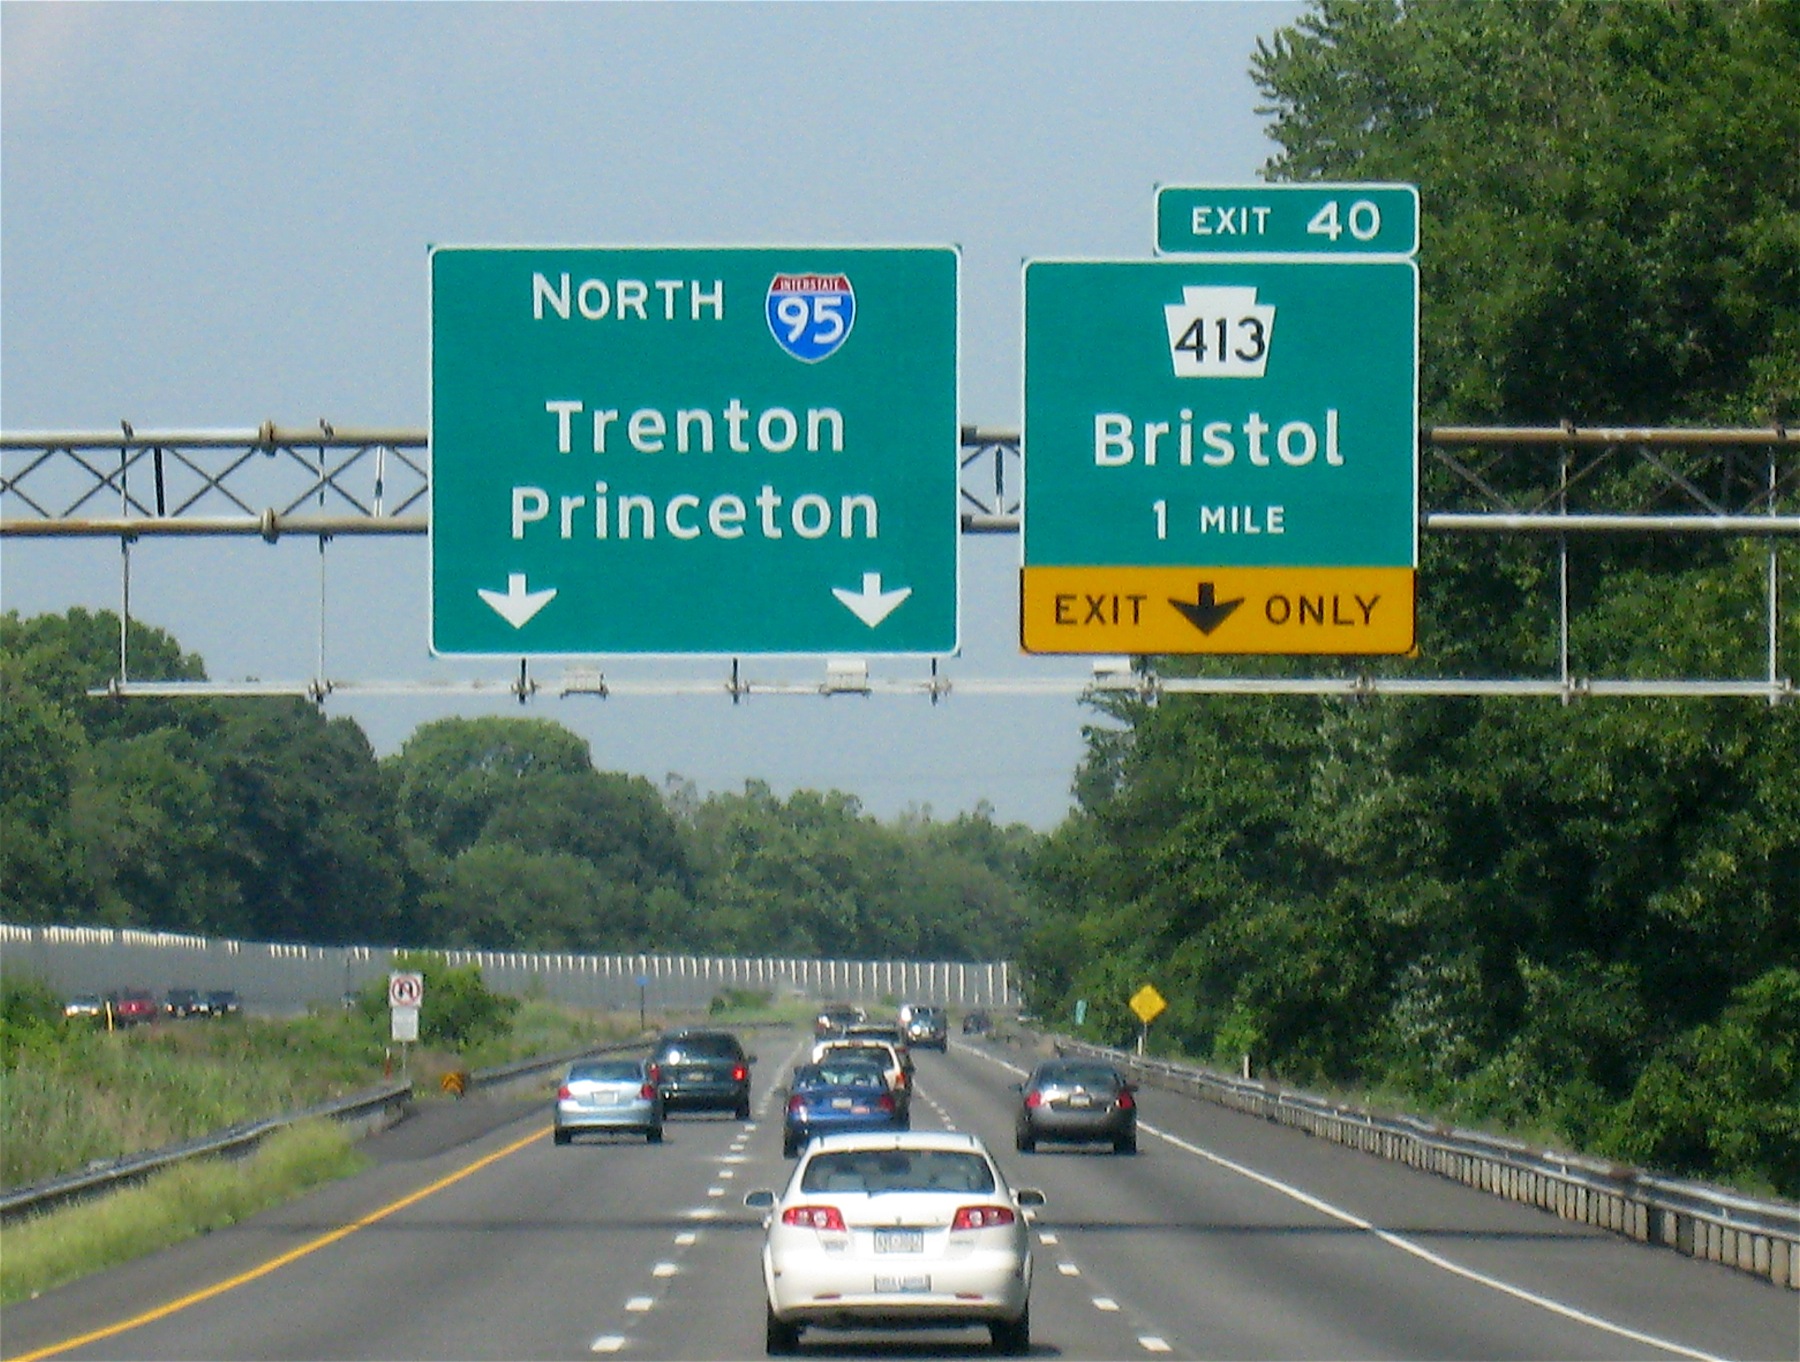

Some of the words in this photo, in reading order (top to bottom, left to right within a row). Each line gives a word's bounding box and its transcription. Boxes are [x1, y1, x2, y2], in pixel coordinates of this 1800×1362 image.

[1192, 206, 1271, 235] EXIT
[1307, 200, 1381, 242] 40
[532, 272, 723, 320] NORTH
[780, 277, 840, 291] INTERSTATE
[776, 295, 845, 345] 95
[1174, 317, 1266, 363] 413
[545, 399, 844, 453] Trenton
[1094, 408, 1345, 467] Bristol
[511, 480, 878, 539] Princeton
[1153, 500, 1167, 540] 1
[1200, 506, 1286, 534] MILE
[1055, 594, 1147, 626] EXIT
[1265, 594, 1381, 626] ONLY
